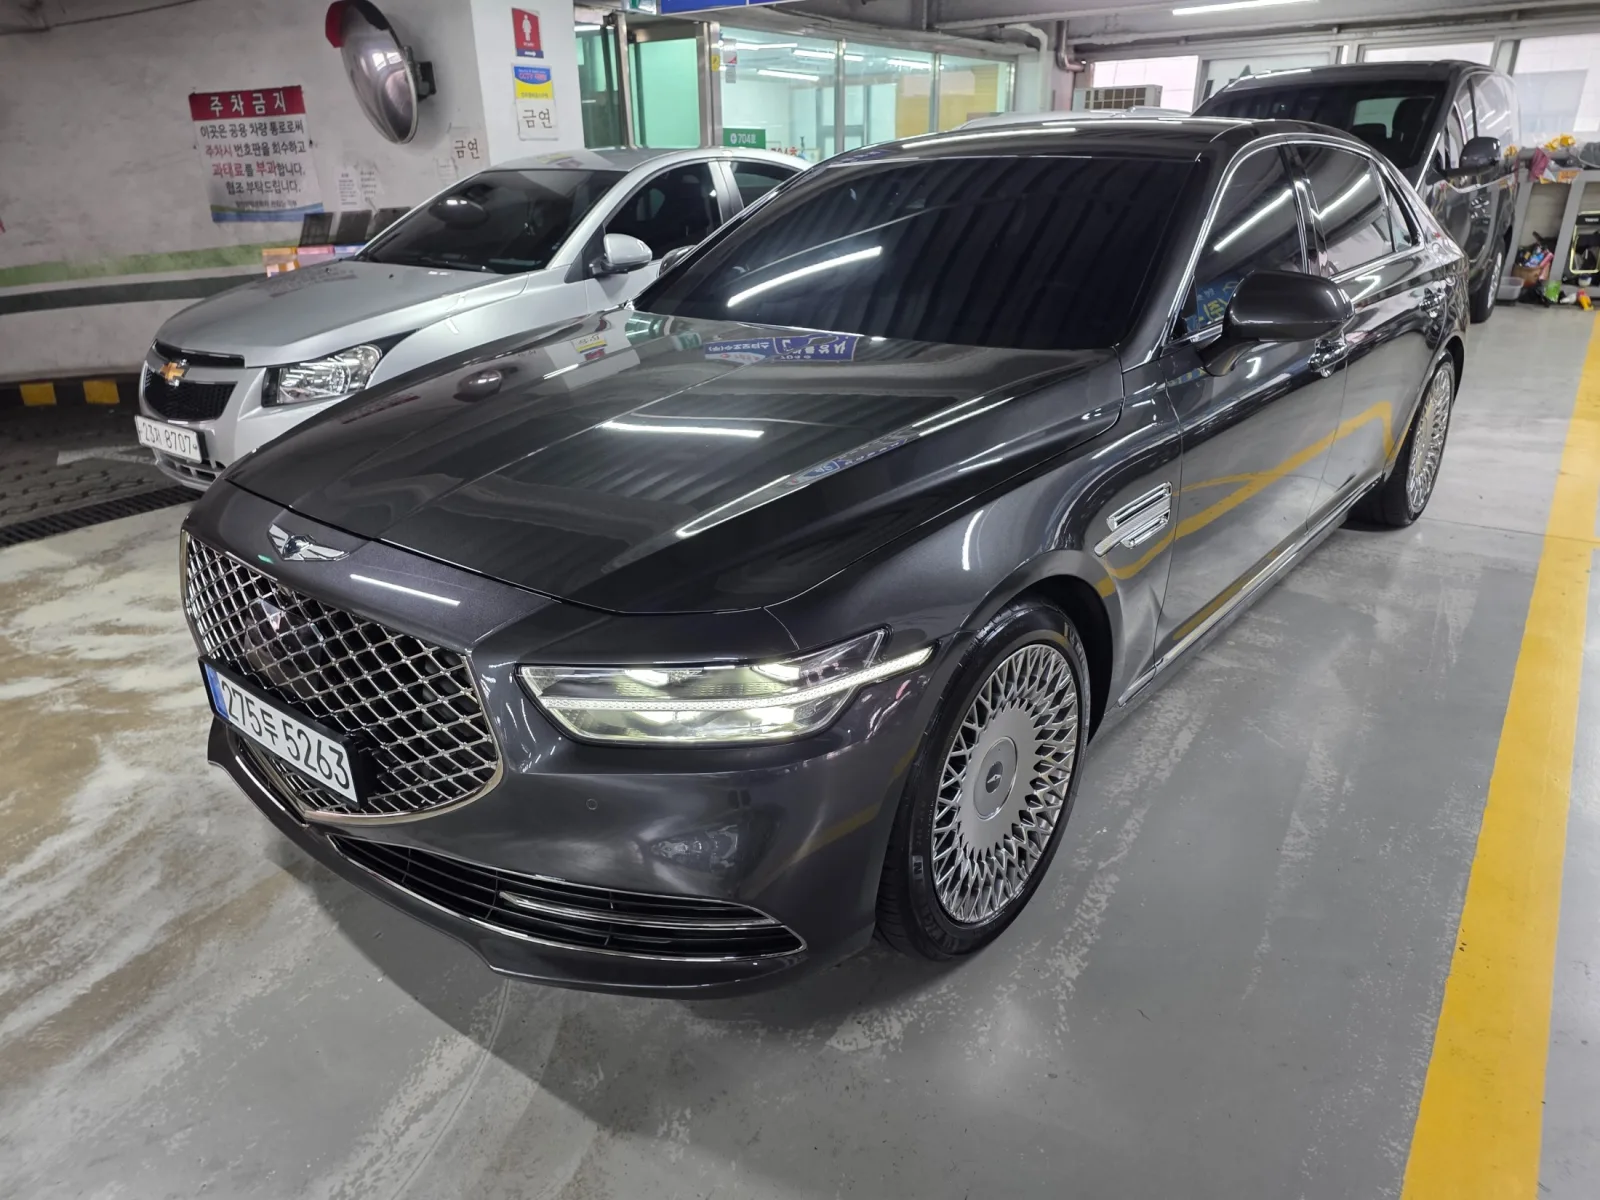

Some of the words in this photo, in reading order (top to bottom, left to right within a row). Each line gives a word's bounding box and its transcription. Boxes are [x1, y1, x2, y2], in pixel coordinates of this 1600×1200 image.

[210, 90, 286, 117] 주차금지
[522, 108, 553, 129] 금연
[200, 124, 227, 139] 이곳은
[229, 123, 248, 138] 공용
[250, 122, 268, 137] 차량
[737, 133, 757, 144] 704호
[205, 144, 233, 158] 주차시
[234, 142, 270, 157] 번호판을
[272, 141, 306, 155] 회수하고
[453, 138, 479, 160] 금연
[212, 162, 255, 177] 과태료를
[225, 181, 244, 195] 협조
[165, 429, 191, 455] 8707
[222, 680, 279, 746] 275두
[281, 719, 350, 790] 5263
